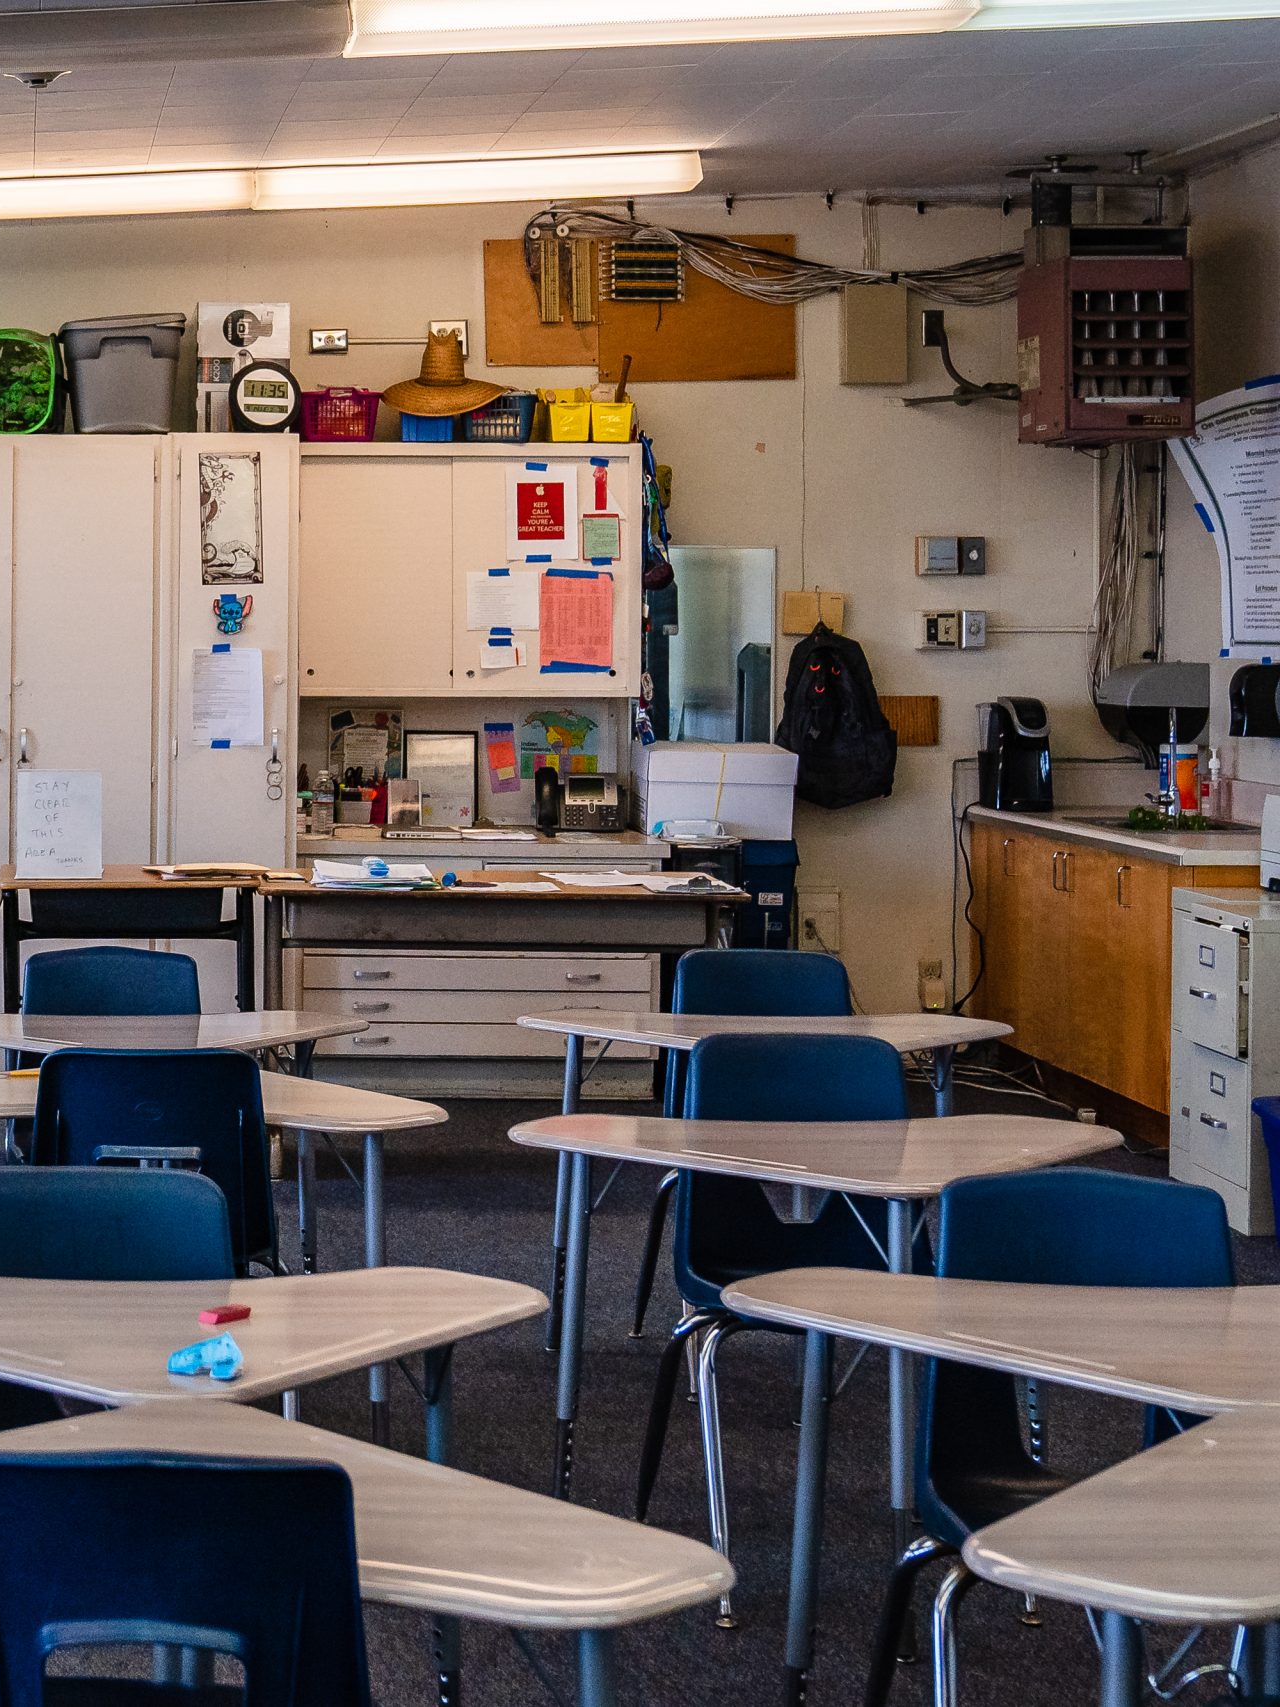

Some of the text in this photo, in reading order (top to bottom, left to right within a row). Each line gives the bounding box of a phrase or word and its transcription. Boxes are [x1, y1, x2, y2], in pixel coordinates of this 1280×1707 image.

[250, 384, 285, 398] 11:35
[34, 781, 70, 793] STAY
[34, 797, 71, 810] CLEAR
[45, 812, 60, 823] OF
[31, 827, 64, 838] THIS
[24, 847, 56, 858] AREA
